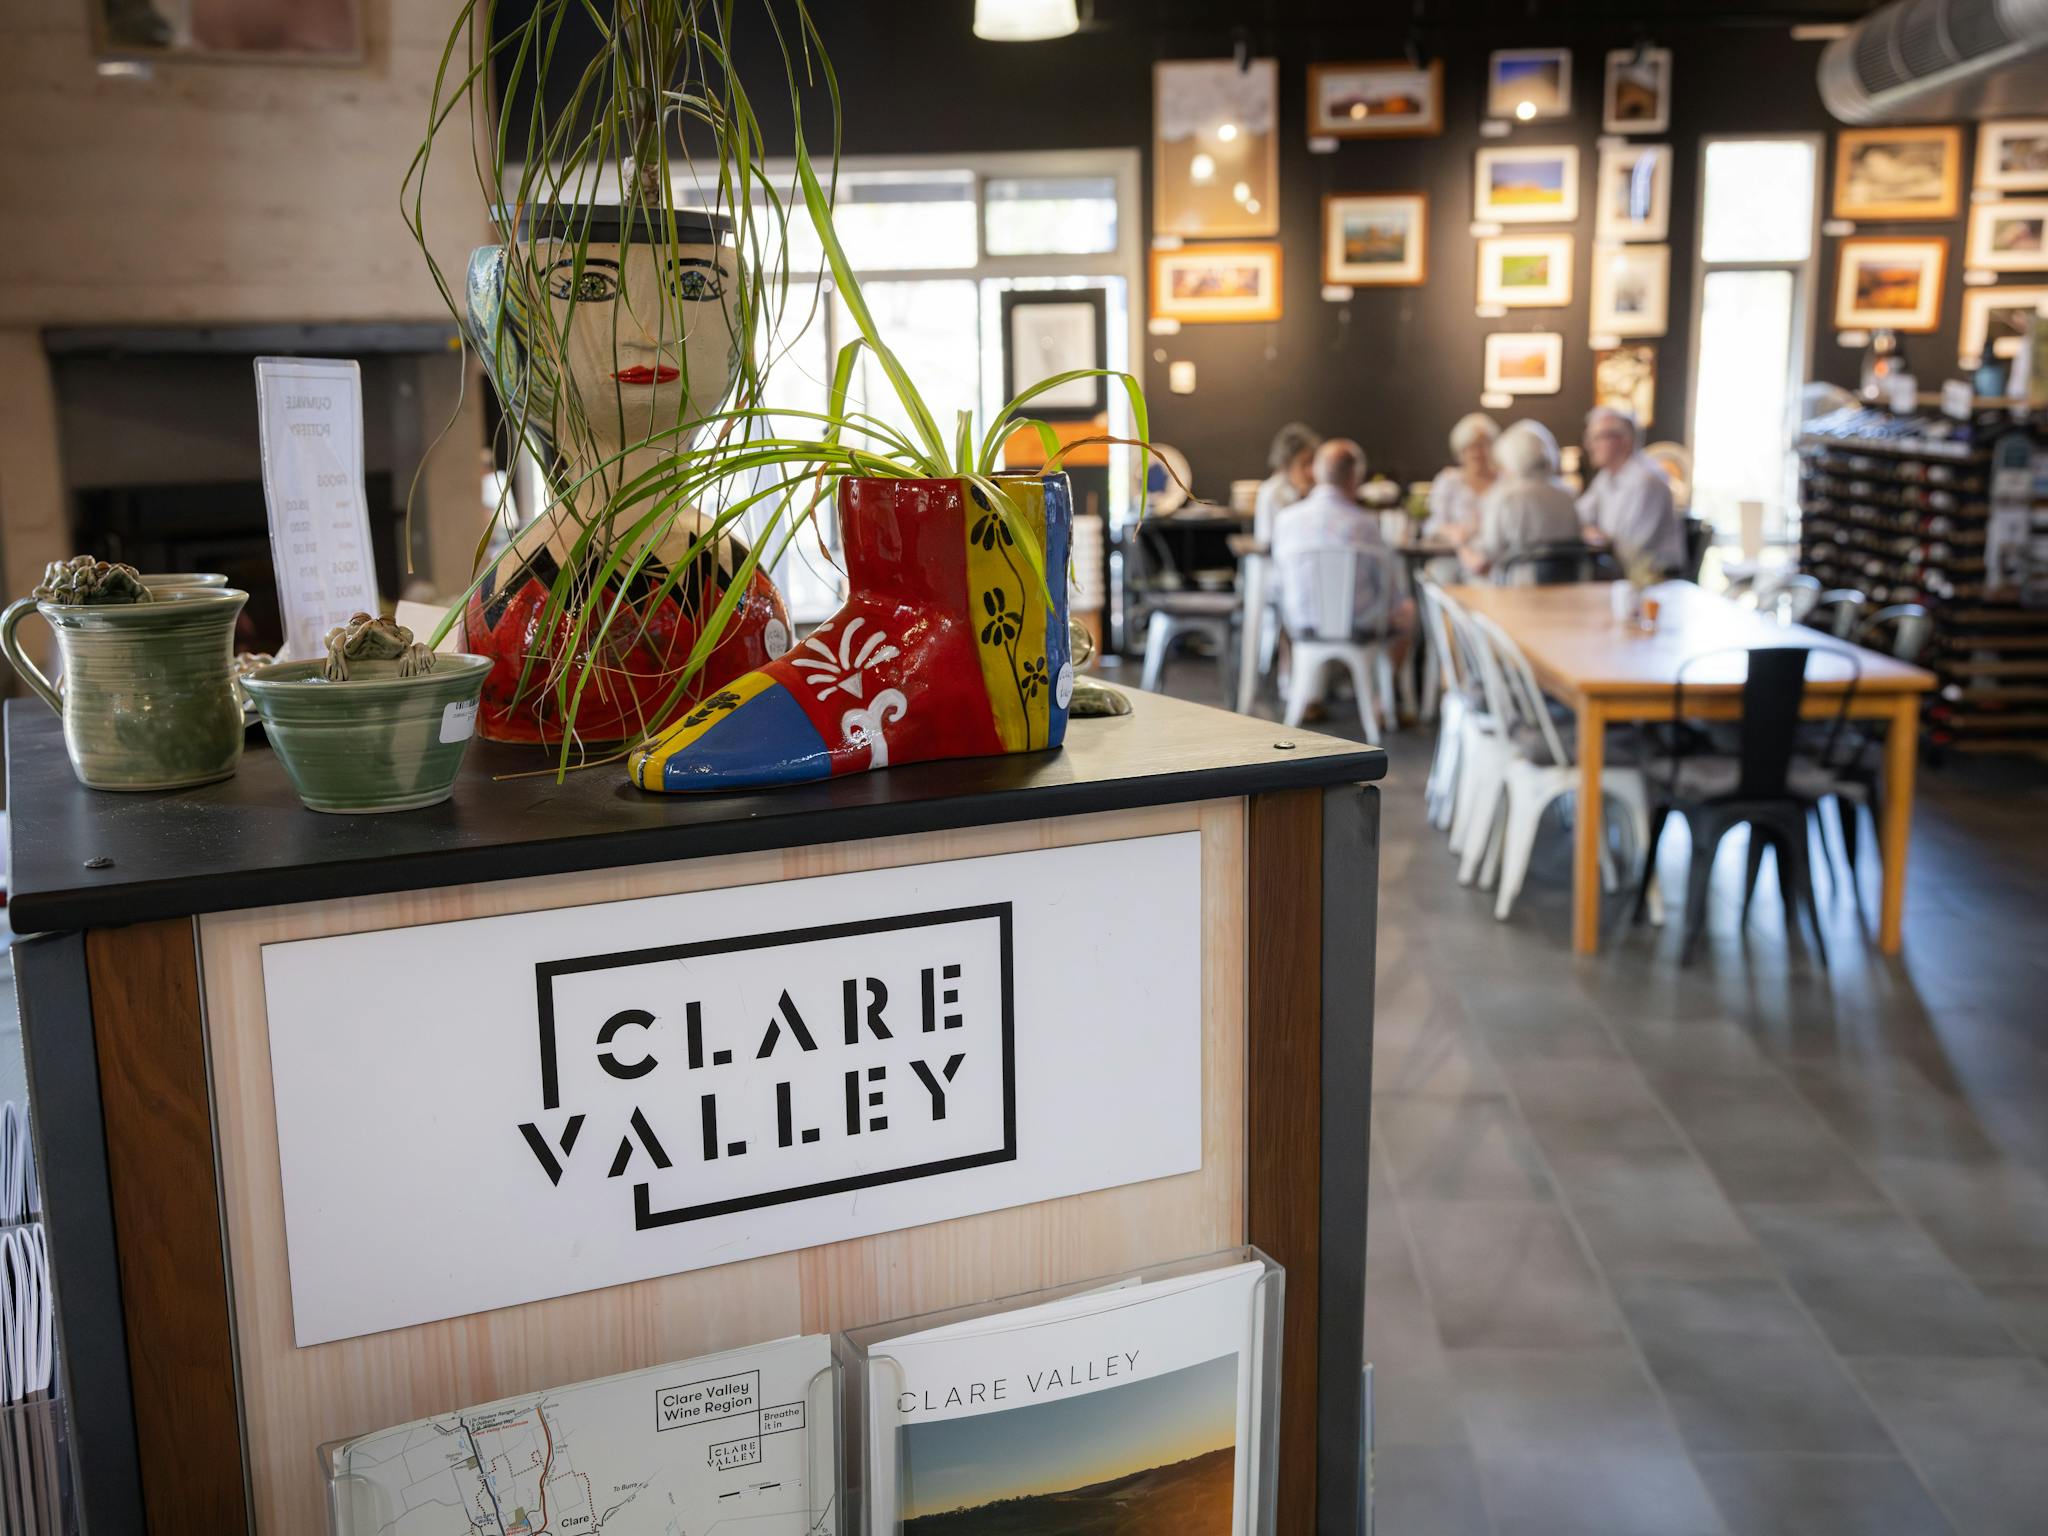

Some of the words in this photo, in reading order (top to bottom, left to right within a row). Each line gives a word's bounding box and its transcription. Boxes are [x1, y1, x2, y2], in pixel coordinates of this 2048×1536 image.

[596, 964, 963, 1080] CLARE
[517, 1053, 966, 1187] VALLEY
[897, 1378, 1007, 1413] CLARE
[1026, 1350, 1139, 1393] VALLEY
[663, 1392, 702, 1407] Clare
[706, 1383, 749, 1398] Valley
[664, 1407, 701, 1421] Wine
[705, 1396, 752, 1413] Region
[764, 1409, 800, 1421] Breathe
[764, 1422, 771, 1430] it
[773, 1421, 782, 1429] in
[714, 1442, 756, 1457] CLARE
[706, 1451, 756, 1467] VALLEY
[621, 1482, 638, 1490] Burra
[561, 1515, 589, 1527] Clare
